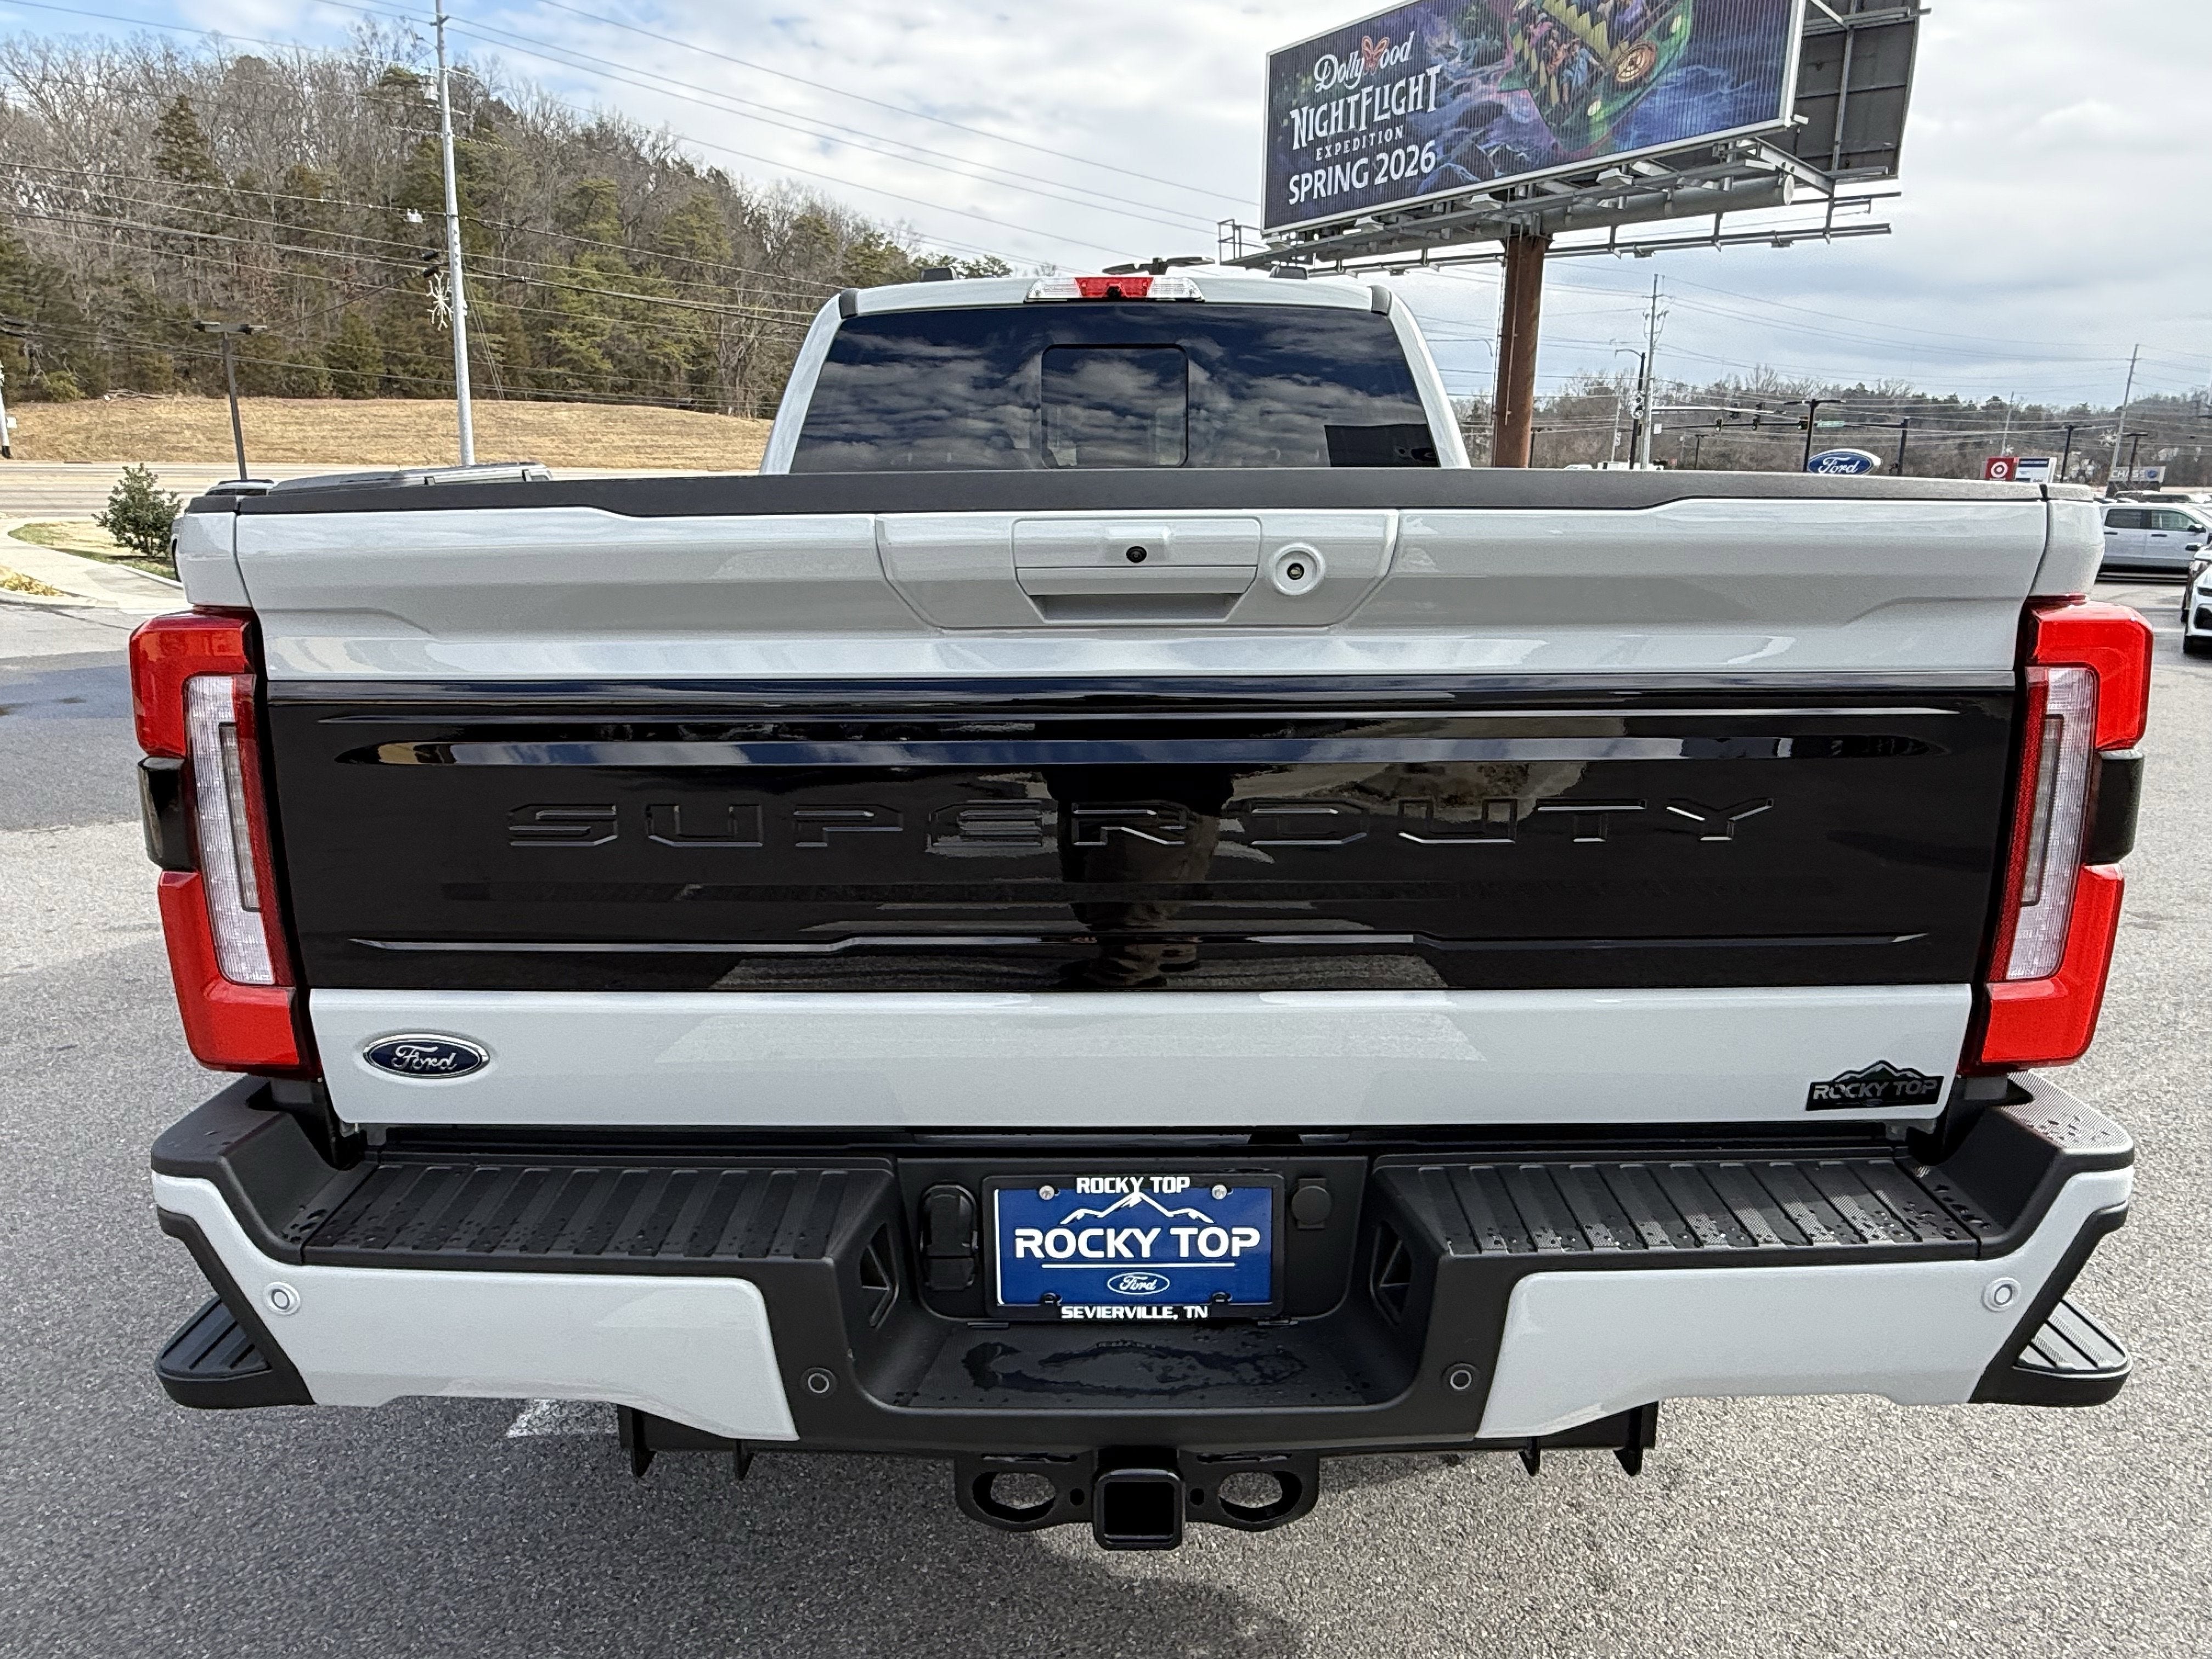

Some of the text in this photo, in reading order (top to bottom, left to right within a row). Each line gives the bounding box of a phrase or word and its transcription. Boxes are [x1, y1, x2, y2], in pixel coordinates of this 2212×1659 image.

[1289, 64, 1443, 150] NIGHTFLIGHT
[1316, 124, 1403, 161] EXPEDITION
[1288, 139, 1436, 205] SPRING 2026
[1818, 456, 1861, 473] Ford
[509, 797, 1775, 848] SUPER DUTY
[391, 1045, 458, 1070] Ford
[1813, 1079, 1938, 1100] ROCKY TOP
[1076, 1176, 1190, 1194] ROCKY TOP
[1015, 1227, 1260, 1259] ROCKY TOP
[1119, 1275, 1156, 1290] Ford
[1061, 1306, 1209, 1320] SEVIERVILLE, TN
